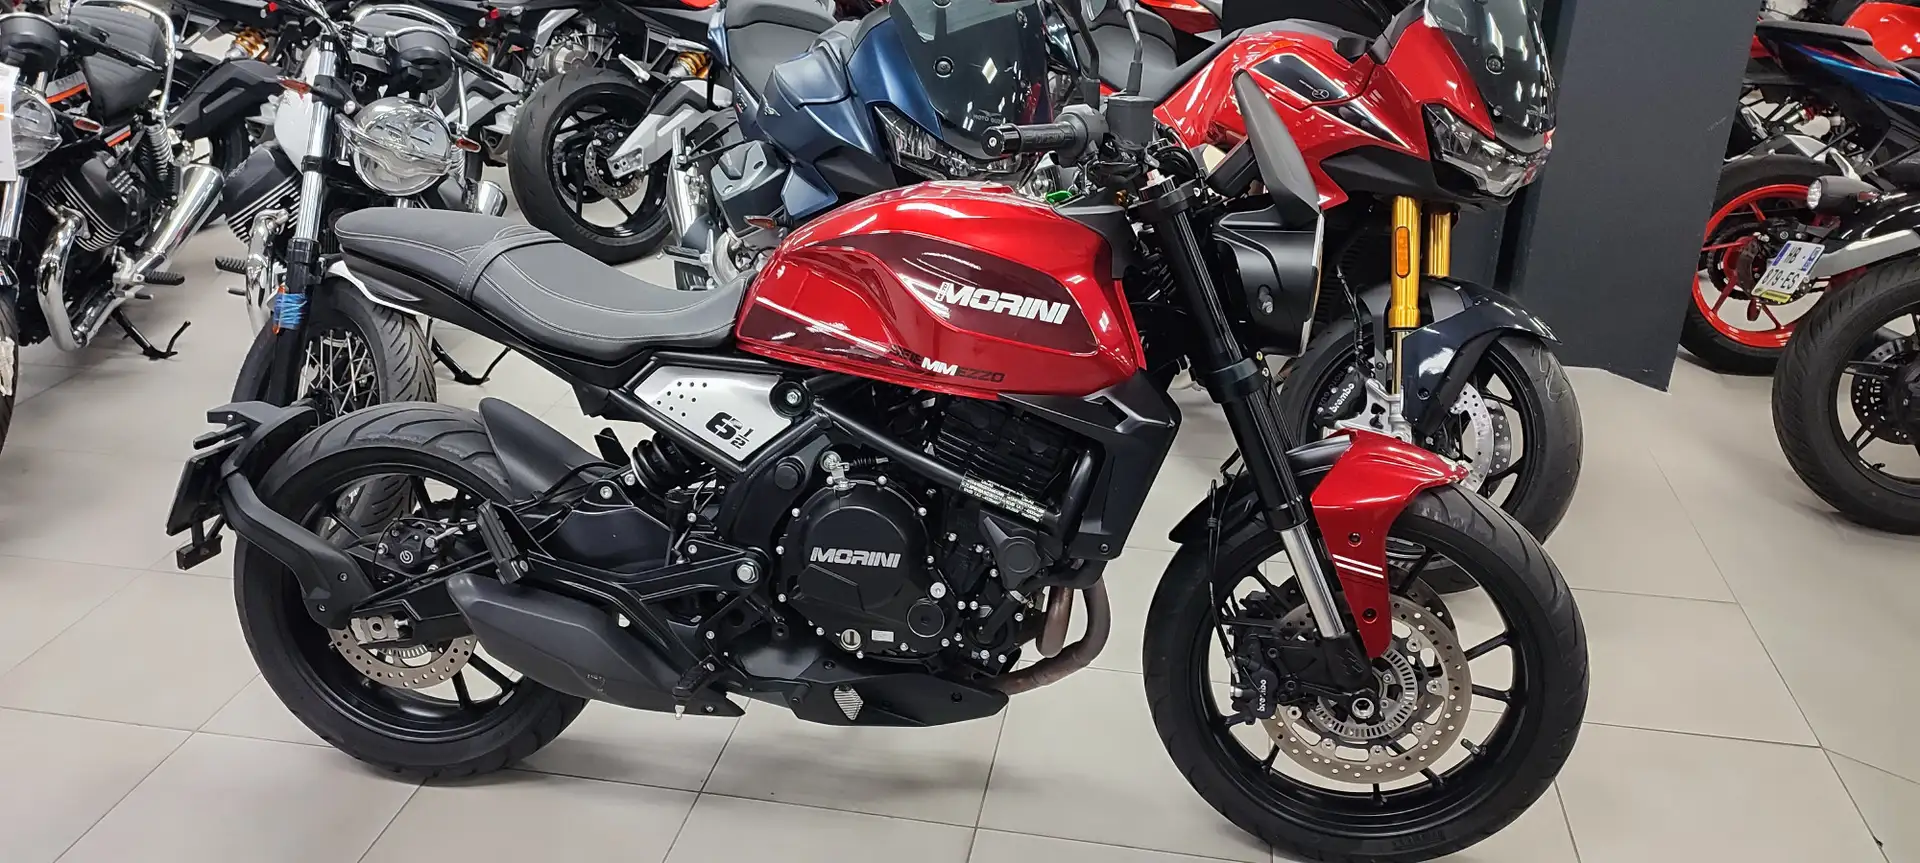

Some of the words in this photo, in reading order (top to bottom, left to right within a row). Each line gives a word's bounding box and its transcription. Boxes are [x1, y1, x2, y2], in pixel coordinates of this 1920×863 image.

[944, 283, 1071, 325] MORINI
[1329, 383, 1355, 413] brembo
[809, 546, 902, 569] MORINI
